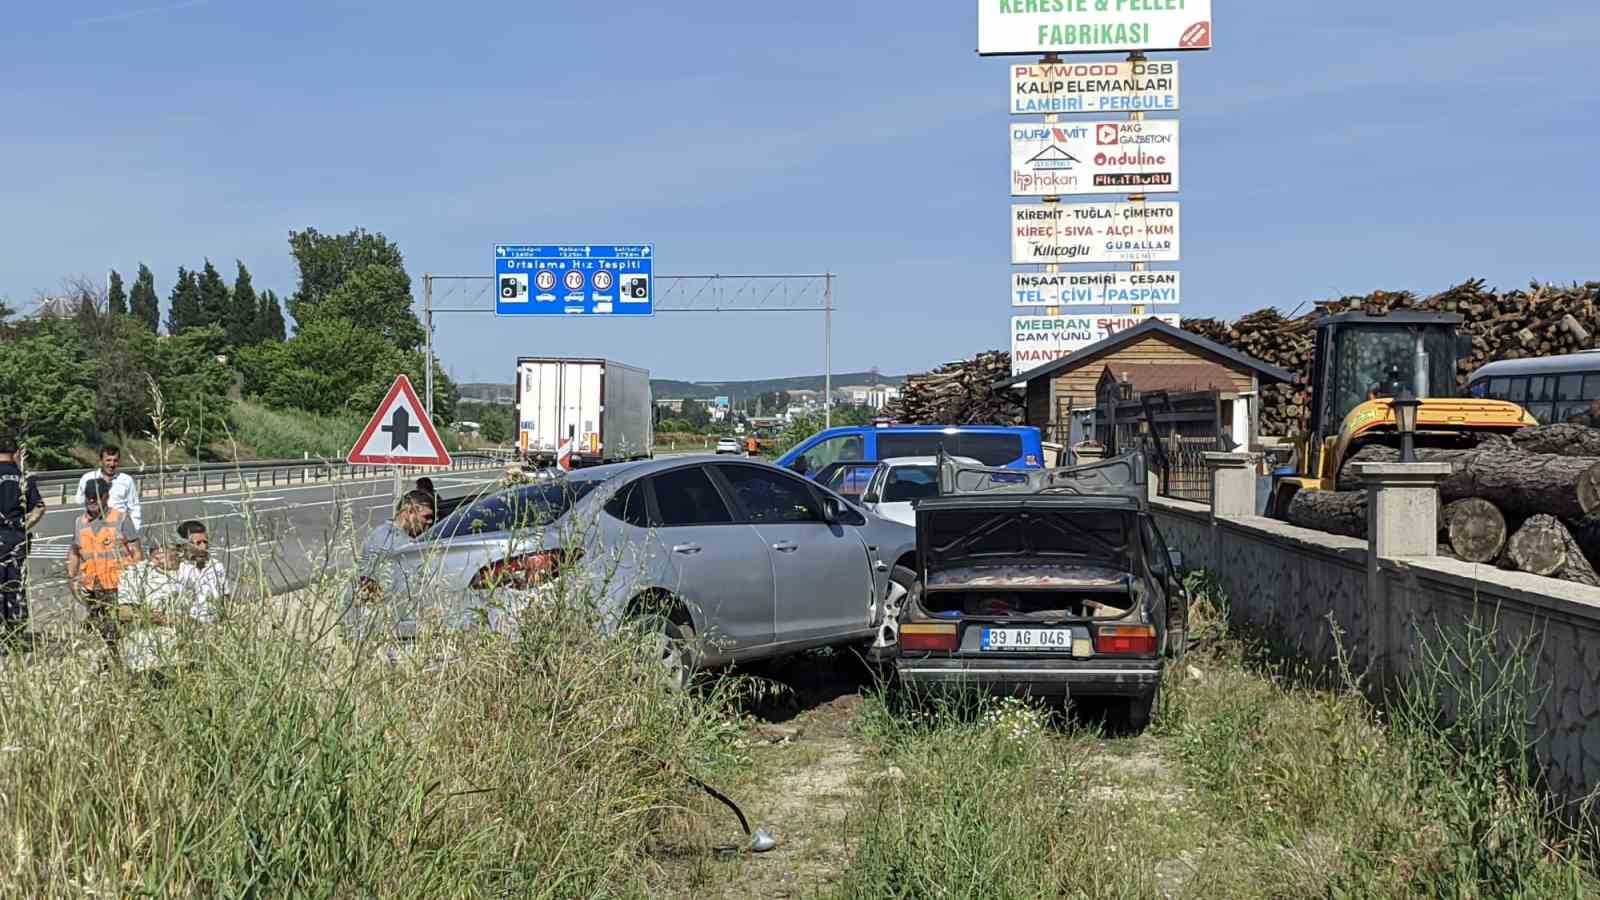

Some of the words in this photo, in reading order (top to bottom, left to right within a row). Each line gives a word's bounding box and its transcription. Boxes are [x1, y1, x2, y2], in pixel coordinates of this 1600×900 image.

[1015, 64, 1118, 77] PLYWOOD
[1132, 63, 1174, 75] OSB
[1016, 80, 1064, 94] KALIP
[1067, 78, 1173, 92] ELEMANLARI
[1015, 95, 1083, 112] LAMBİRİ
[1099, 95, 1174, 110] PERGULE
[1119, 123, 1142, 133] AKG
[1016, 208, 1063, 220] KİREMİT
[1074, 206, 1112, 219] TUĞLA
[1123, 206, 1174, 221] ÇİMENTO
[1016, 224, 1054, 238] KİREÇ
[1065, 226, 1094, 236] SIVA
[1106, 225, 1134, 238] ALÇI
[1146, 225, 1174, 235] KUM
[507, 259, 565, 269] Ortalama
[599, 259, 640, 271] Tespiti
[540, 276, 553, 285] 70
[568, 276, 582, 285] 70
[597, 275, 609, 285] 70
[1016, 274, 1066, 287] İNŞAAT
[1070, 273, 1116, 285] DEMİRİ
[1016, 290, 1045, 302] TEL
[1061, 287, 1092, 303] ÇİVİ
[1108, 288, 1176, 301] PASPAYI
[1016, 319, 1090, 330] MEBRAN
[1016, 332, 1049, 342] CAM
[1052, 329, 1092, 341] YÜNÜ
[991, 631, 1007, 645] 39
[1015, 631, 1032, 645] AG
[1039, 631, 1065, 645] 046
